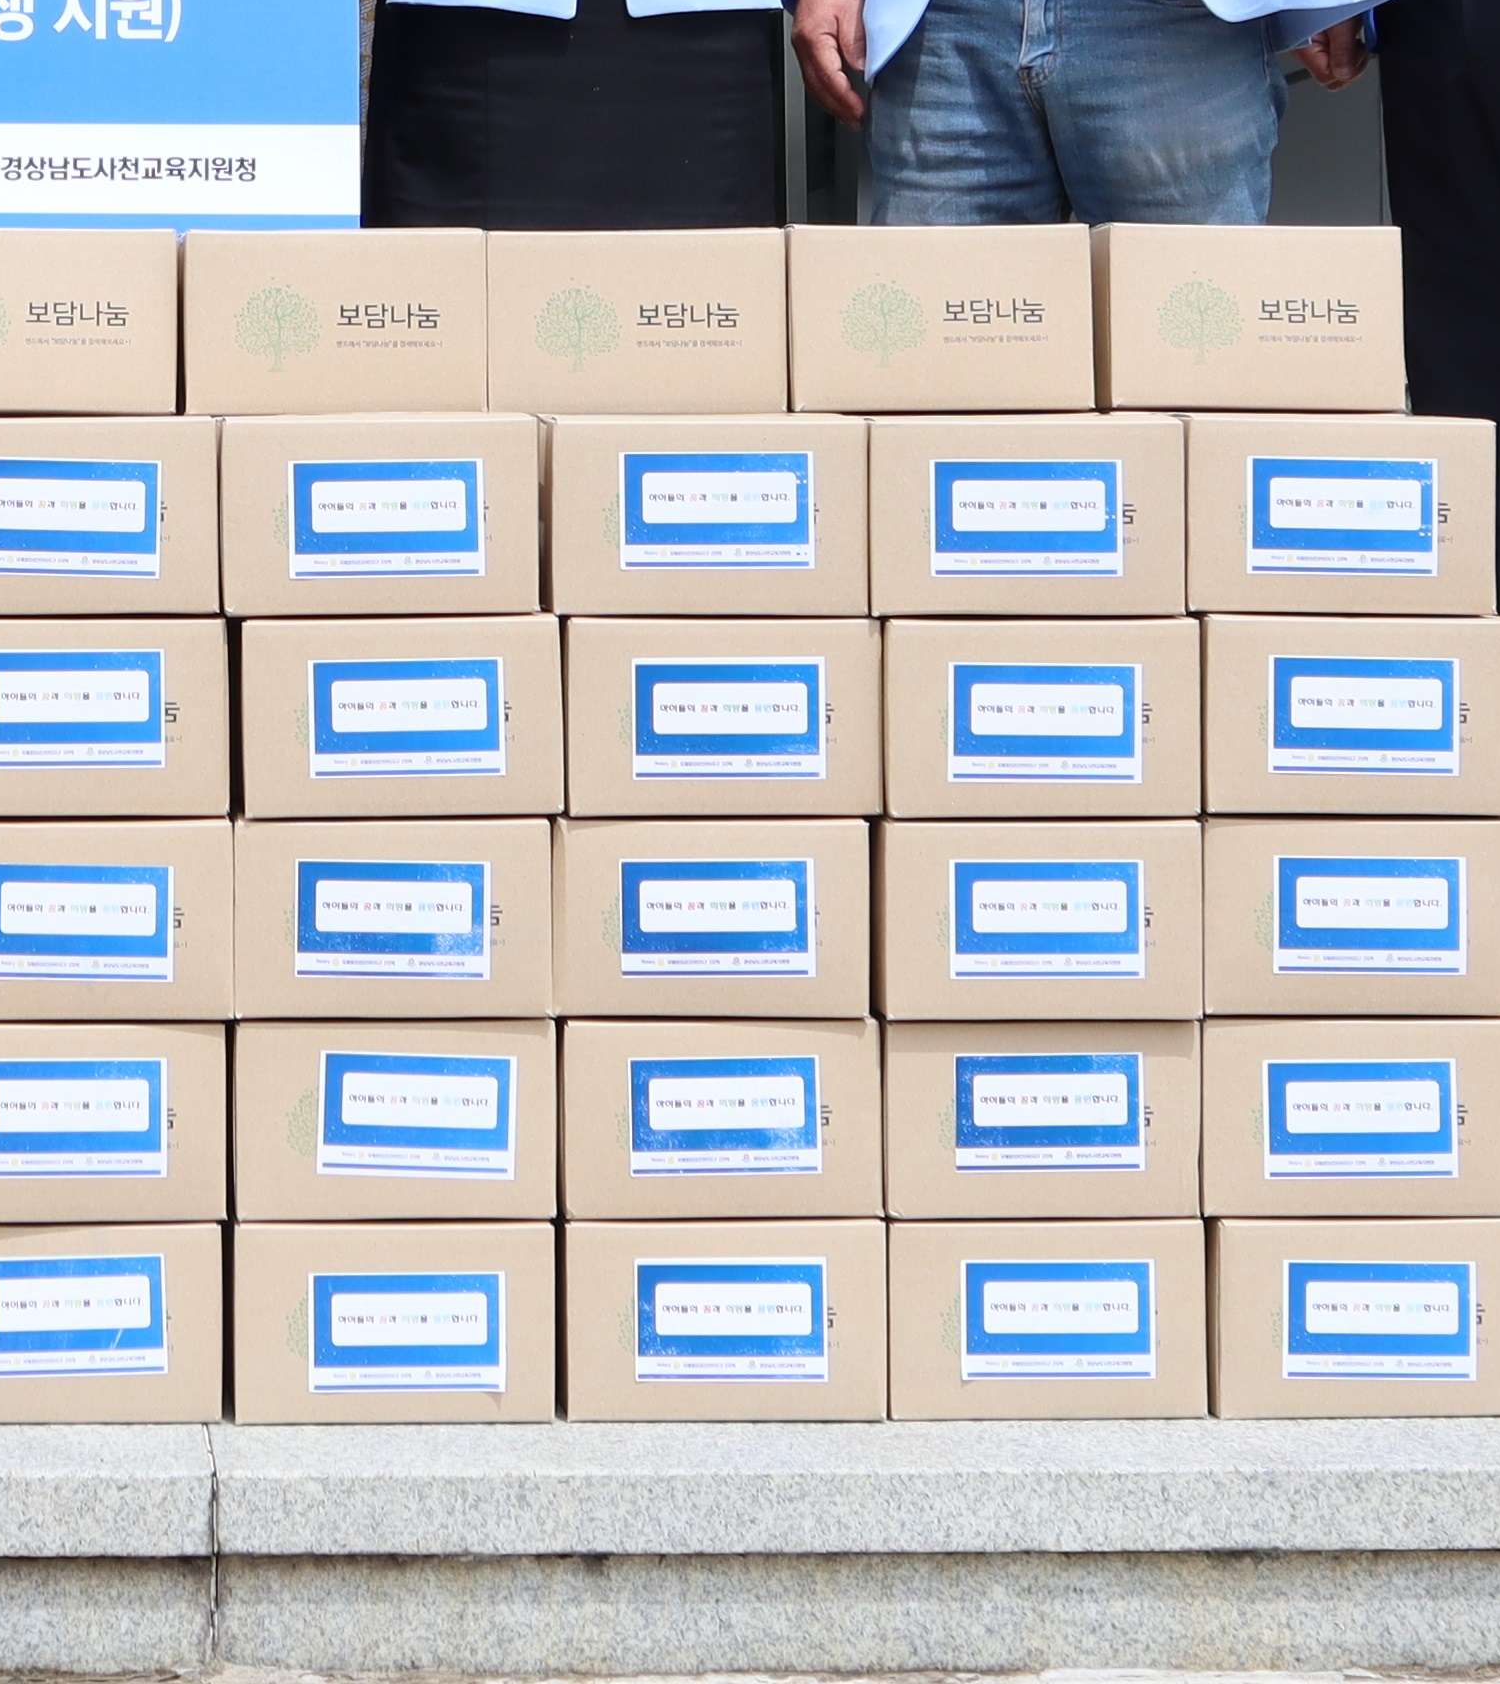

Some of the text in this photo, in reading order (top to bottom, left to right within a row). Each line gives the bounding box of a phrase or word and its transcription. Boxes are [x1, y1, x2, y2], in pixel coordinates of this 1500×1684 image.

[0, 155, 258, 184] 경상남도사천교육지원청
[25, 300, 130, 327] 보담나눔
[336, 302, 440, 329] 보담나눔
[636, 302, 741, 329] 보담나눔
[942, 297, 1046, 324] 보담나눔
[1258, 298, 1360, 324] 보담나눔
